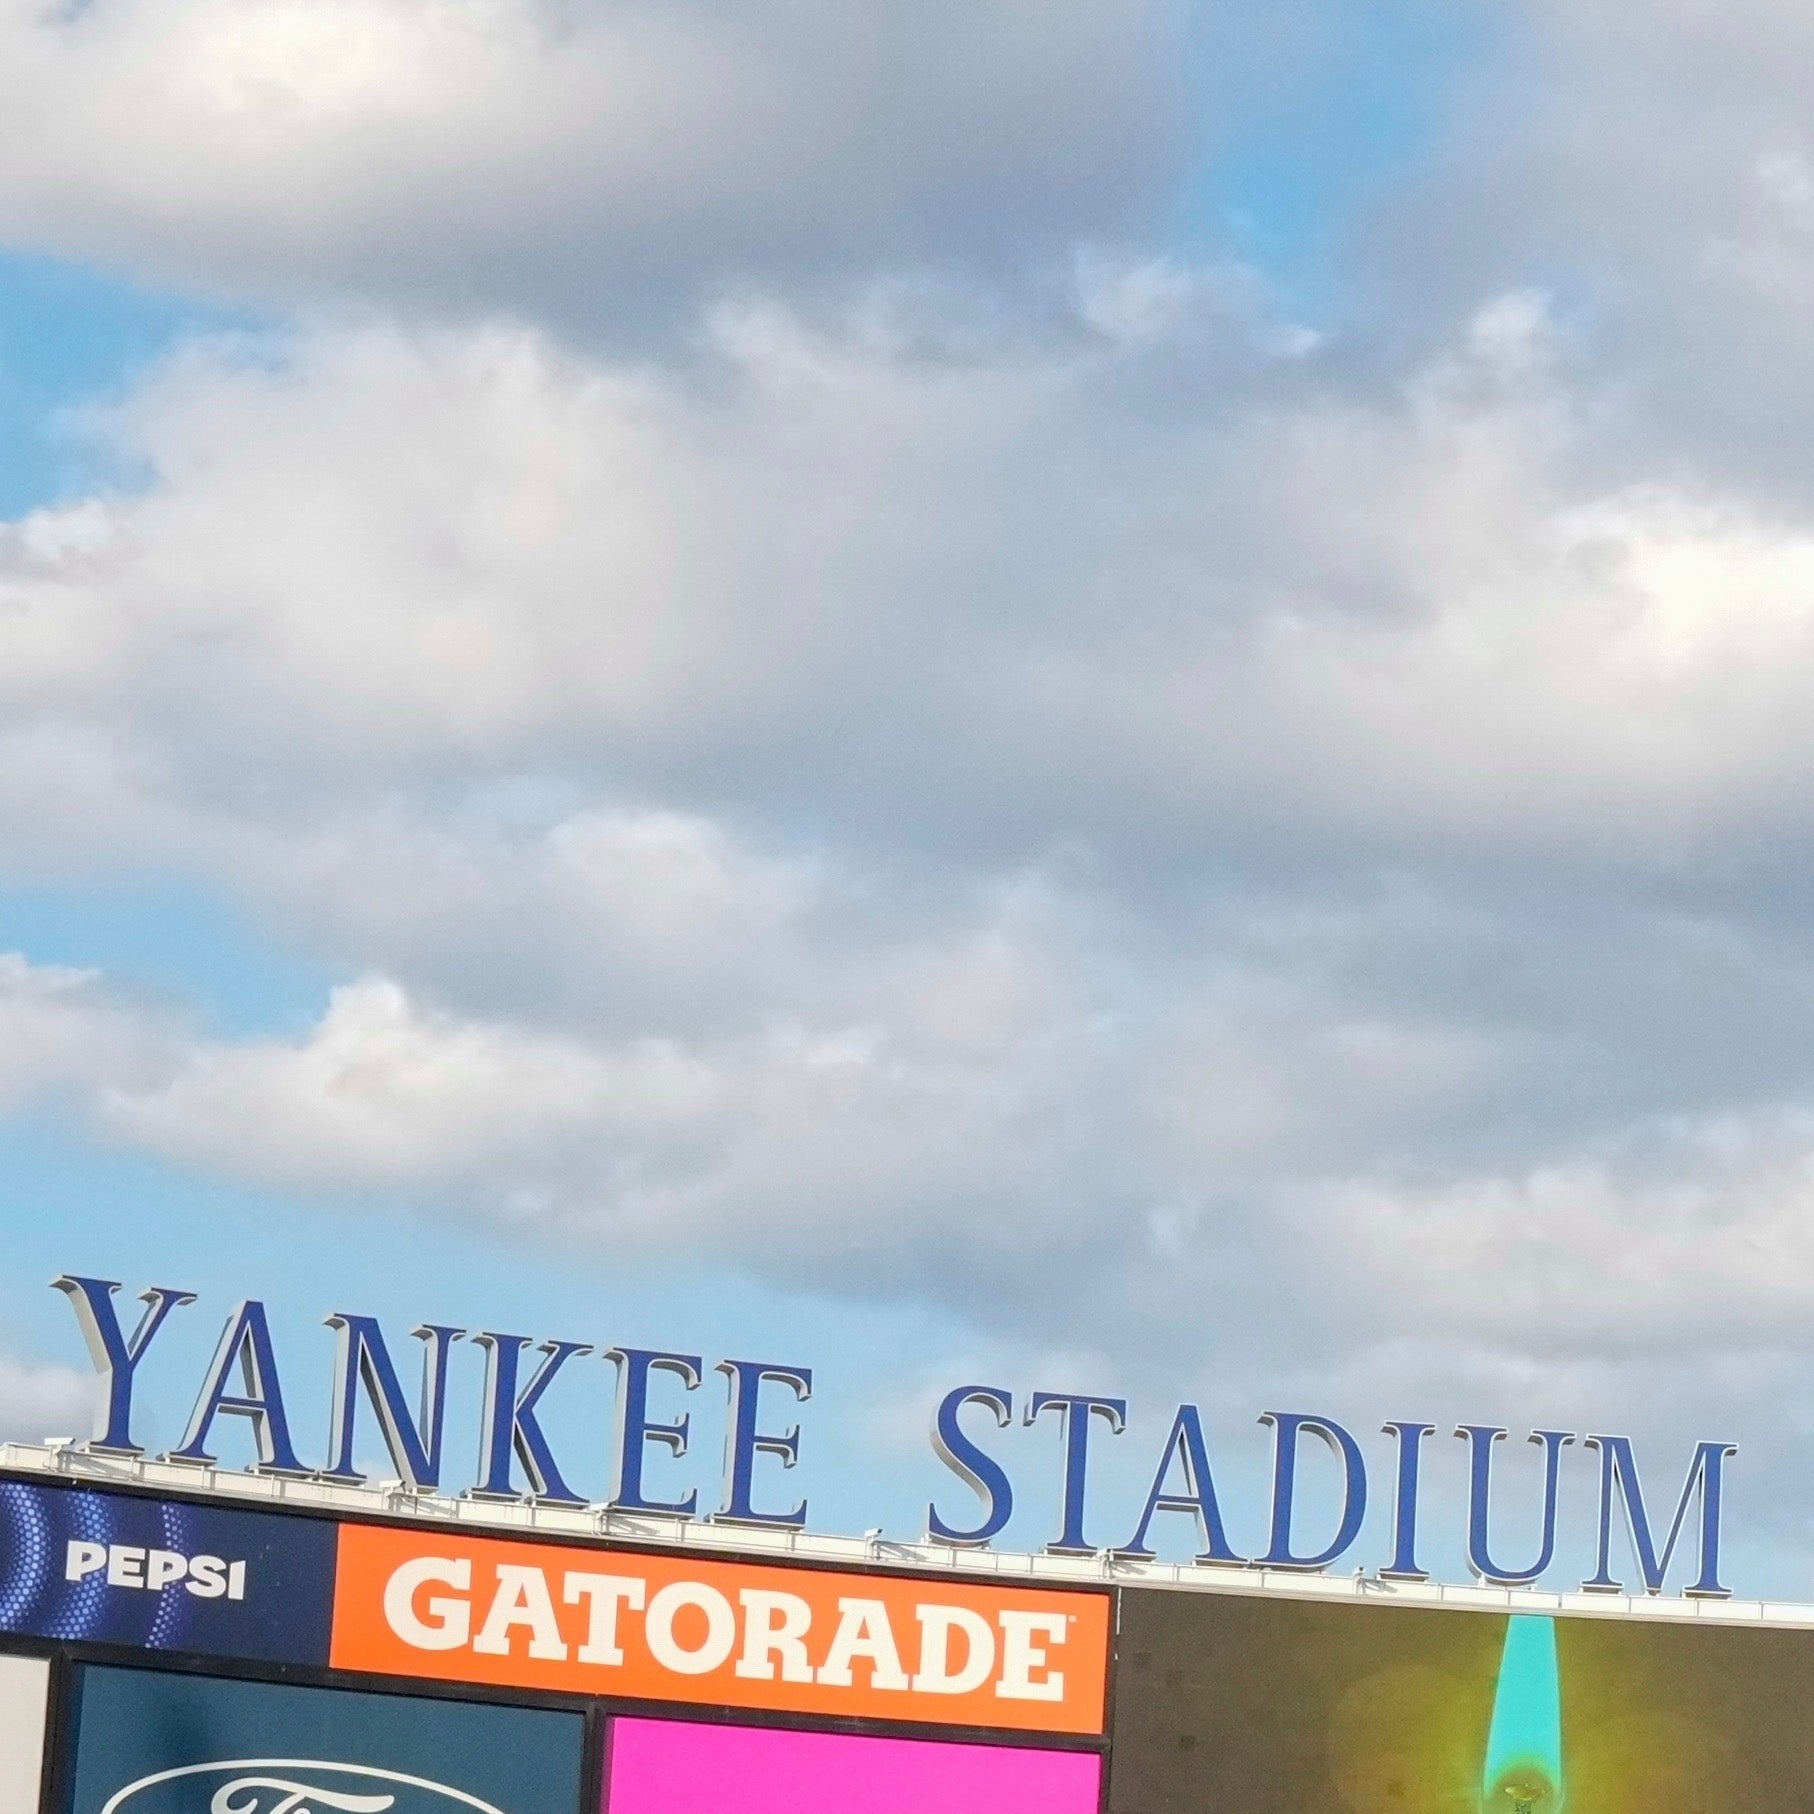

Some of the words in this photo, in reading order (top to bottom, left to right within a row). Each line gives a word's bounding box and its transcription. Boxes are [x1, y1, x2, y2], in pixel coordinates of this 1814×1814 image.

[50, 1275, 813, 1530] YANKEE
[928, 1384, 1739, 1598] STADIUM
[65, 1540, 246, 1601] PEPSI
[383, 1556, 1066, 1703] GATORADE
